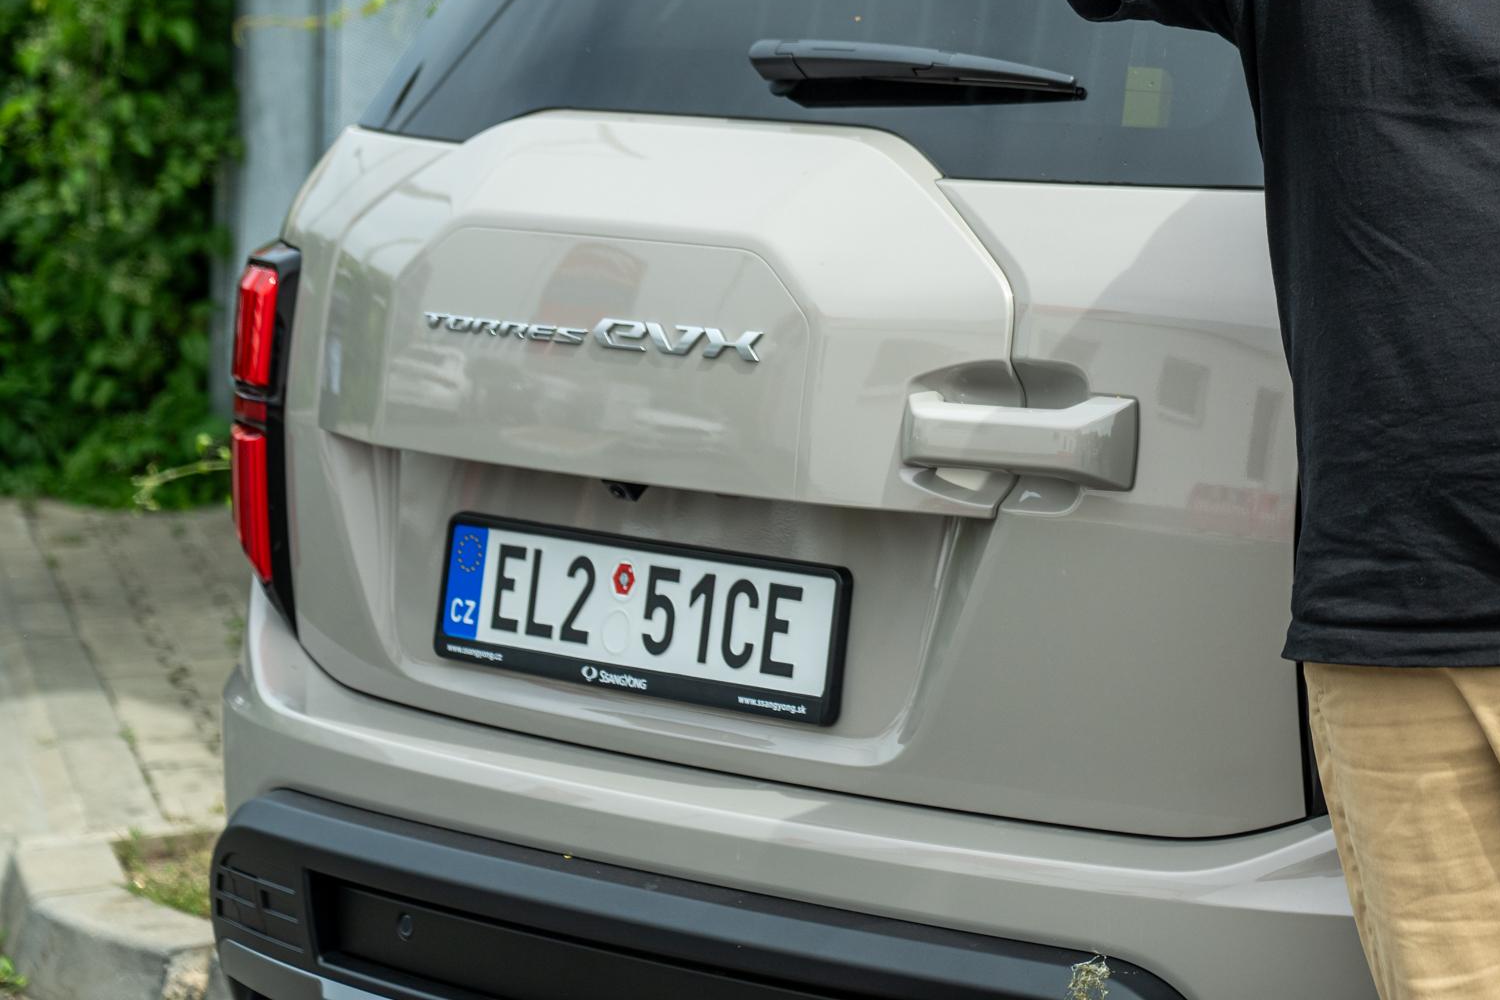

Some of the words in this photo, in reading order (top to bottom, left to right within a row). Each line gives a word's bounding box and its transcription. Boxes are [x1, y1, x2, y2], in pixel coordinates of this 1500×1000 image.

[424, 311, 588, 346] TORRES
[450, 596, 476, 626] CZ
[490, 543, 597, 645] EL2
[641, 565, 804, 679] 51CE
[737, 695, 807, 715] www.ssangyong.sk
